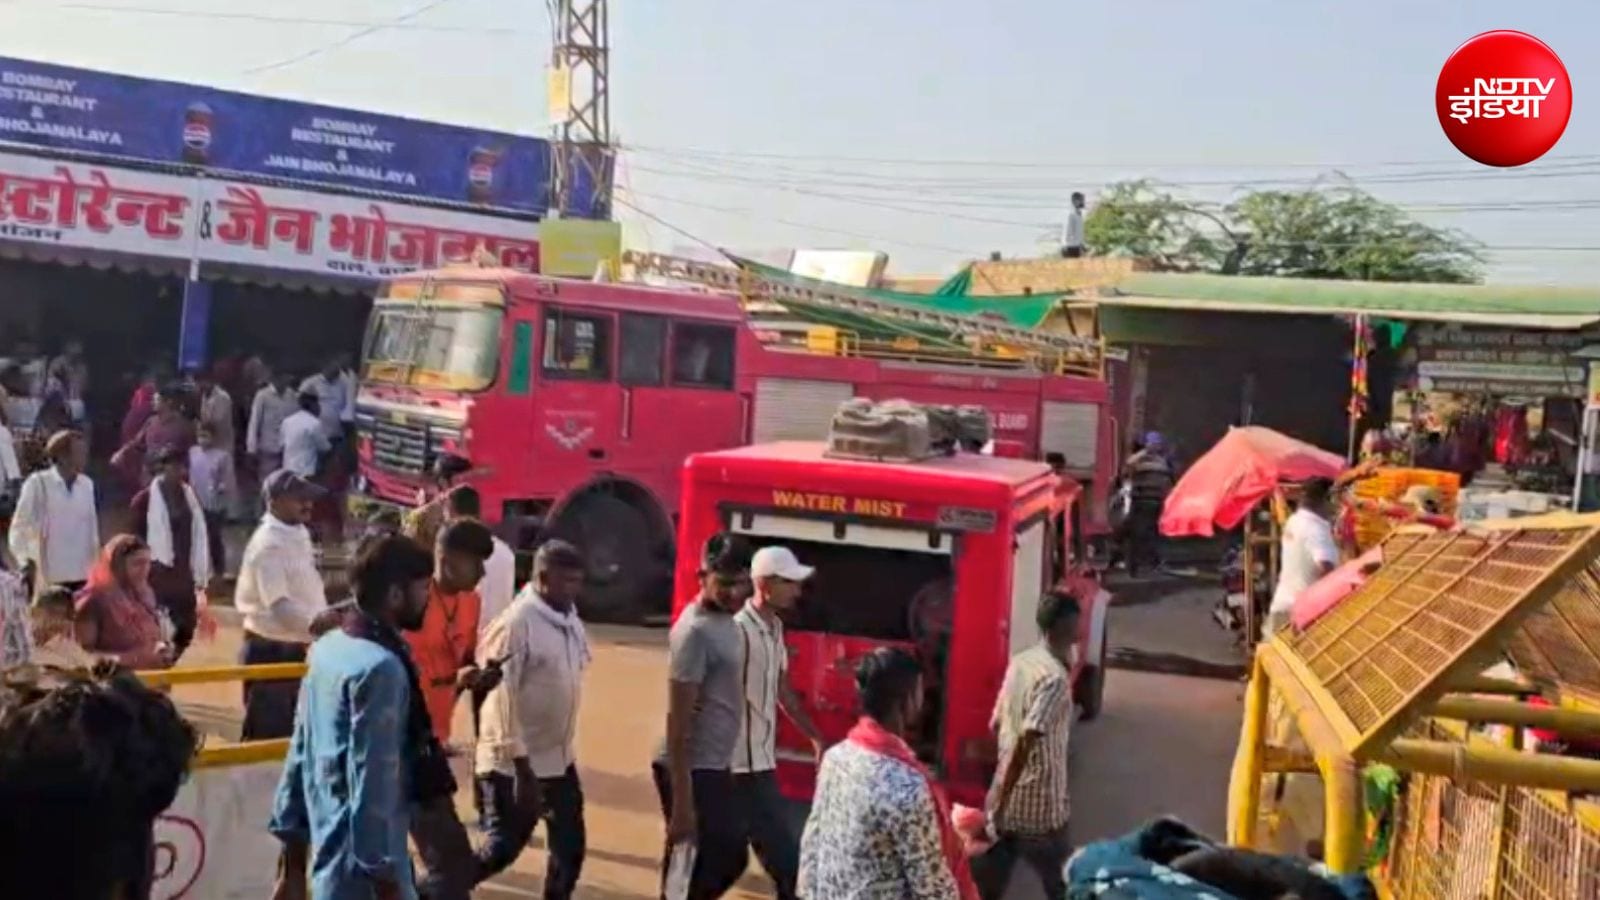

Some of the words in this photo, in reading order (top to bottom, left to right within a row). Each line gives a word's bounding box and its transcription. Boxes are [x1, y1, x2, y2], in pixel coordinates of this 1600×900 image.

[3, 71, 77, 92] BOMBAY
[0, 86, 98, 111] STAURANT
[31, 105, 44, 119] &
[0, 116, 122, 145] HOJANALAYA
[312, 118, 377, 136] BOMBAY
[291, 128, 395, 153] RESTAURANT
[336, 149, 348, 161] &
[264, 155, 300, 169] JAIN
[302, 158, 417, 186] BHOJANALAYA
[0, 165, 191, 240] टोरेन्ट
[200, 200, 212, 240] &
[217, 186, 322, 255] जैन
[772, 489, 847, 513] WATER
[854, 497, 907, 518] MIST
